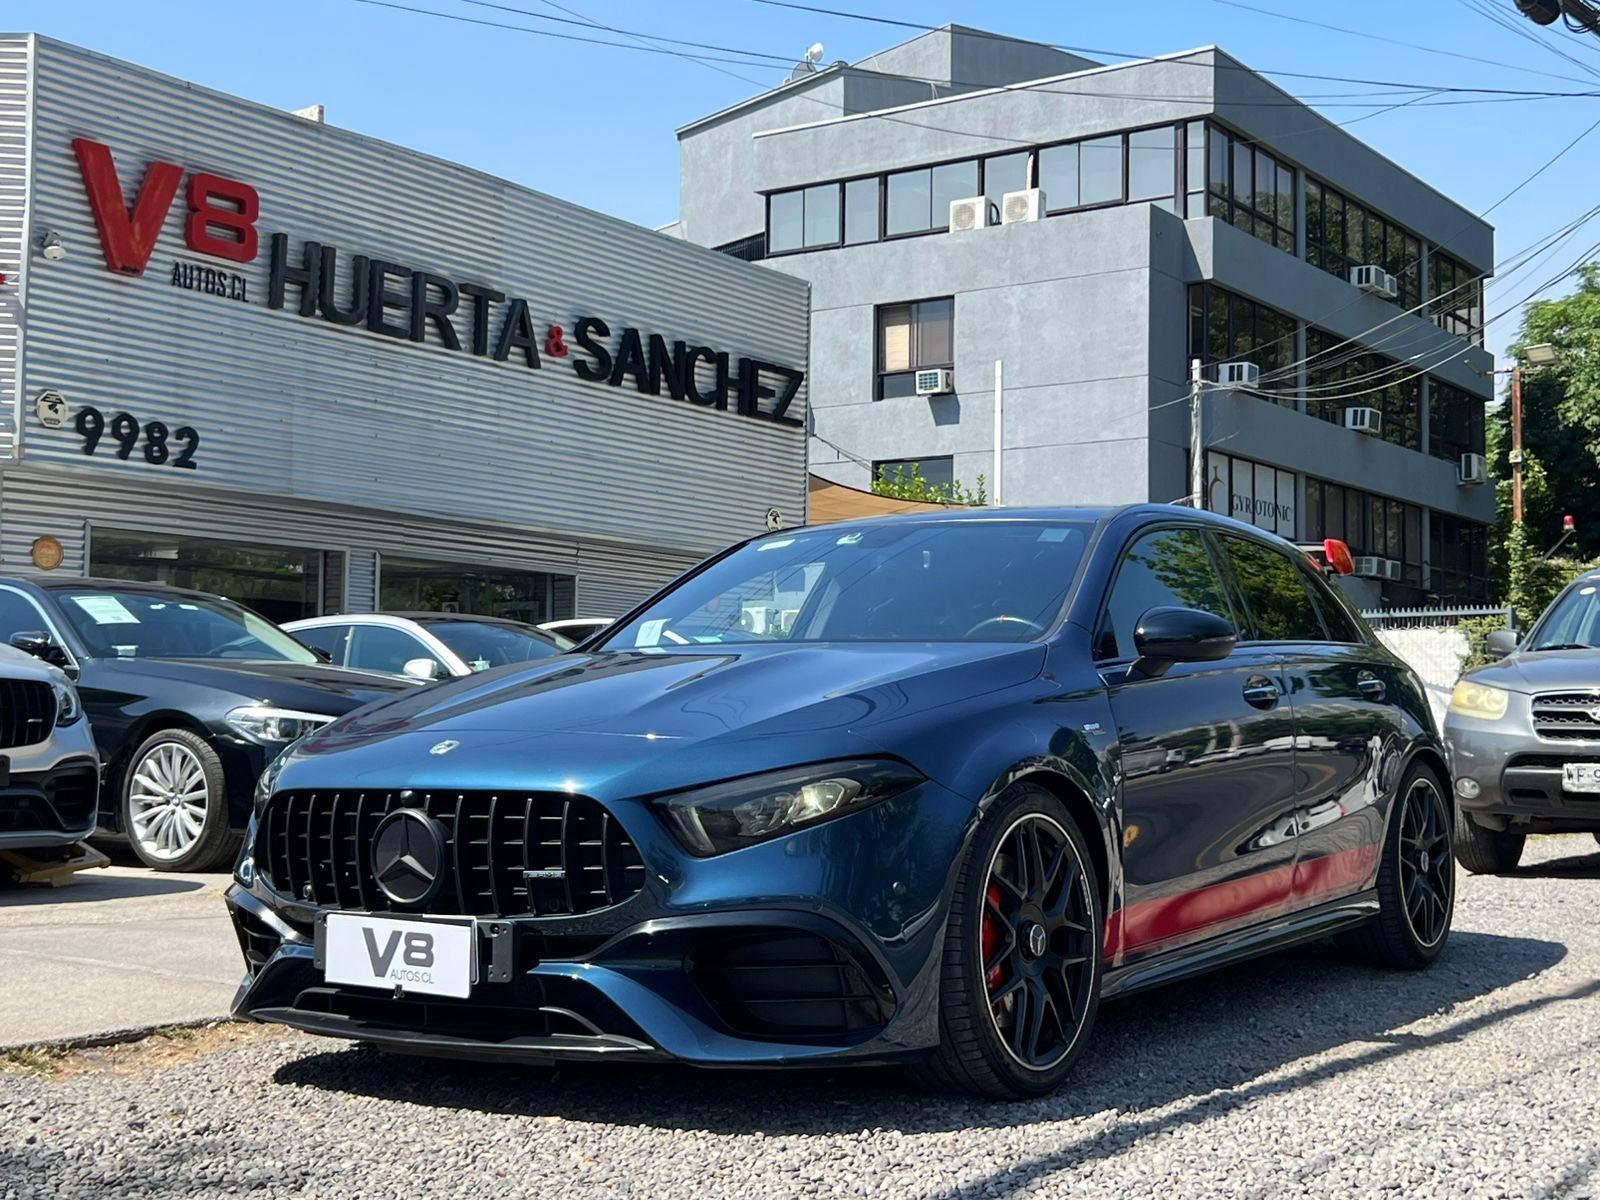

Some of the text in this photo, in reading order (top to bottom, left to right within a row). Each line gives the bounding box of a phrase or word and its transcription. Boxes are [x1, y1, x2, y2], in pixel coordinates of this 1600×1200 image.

[72, 138, 259, 273] V8
[267, 233, 804, 427] HUERTA & SANCHEZ
[75, 406, 200, 470] 9982
[1232, 494, 1291, 522] GYROTONIC
[362, 927, 434, 978] V8
